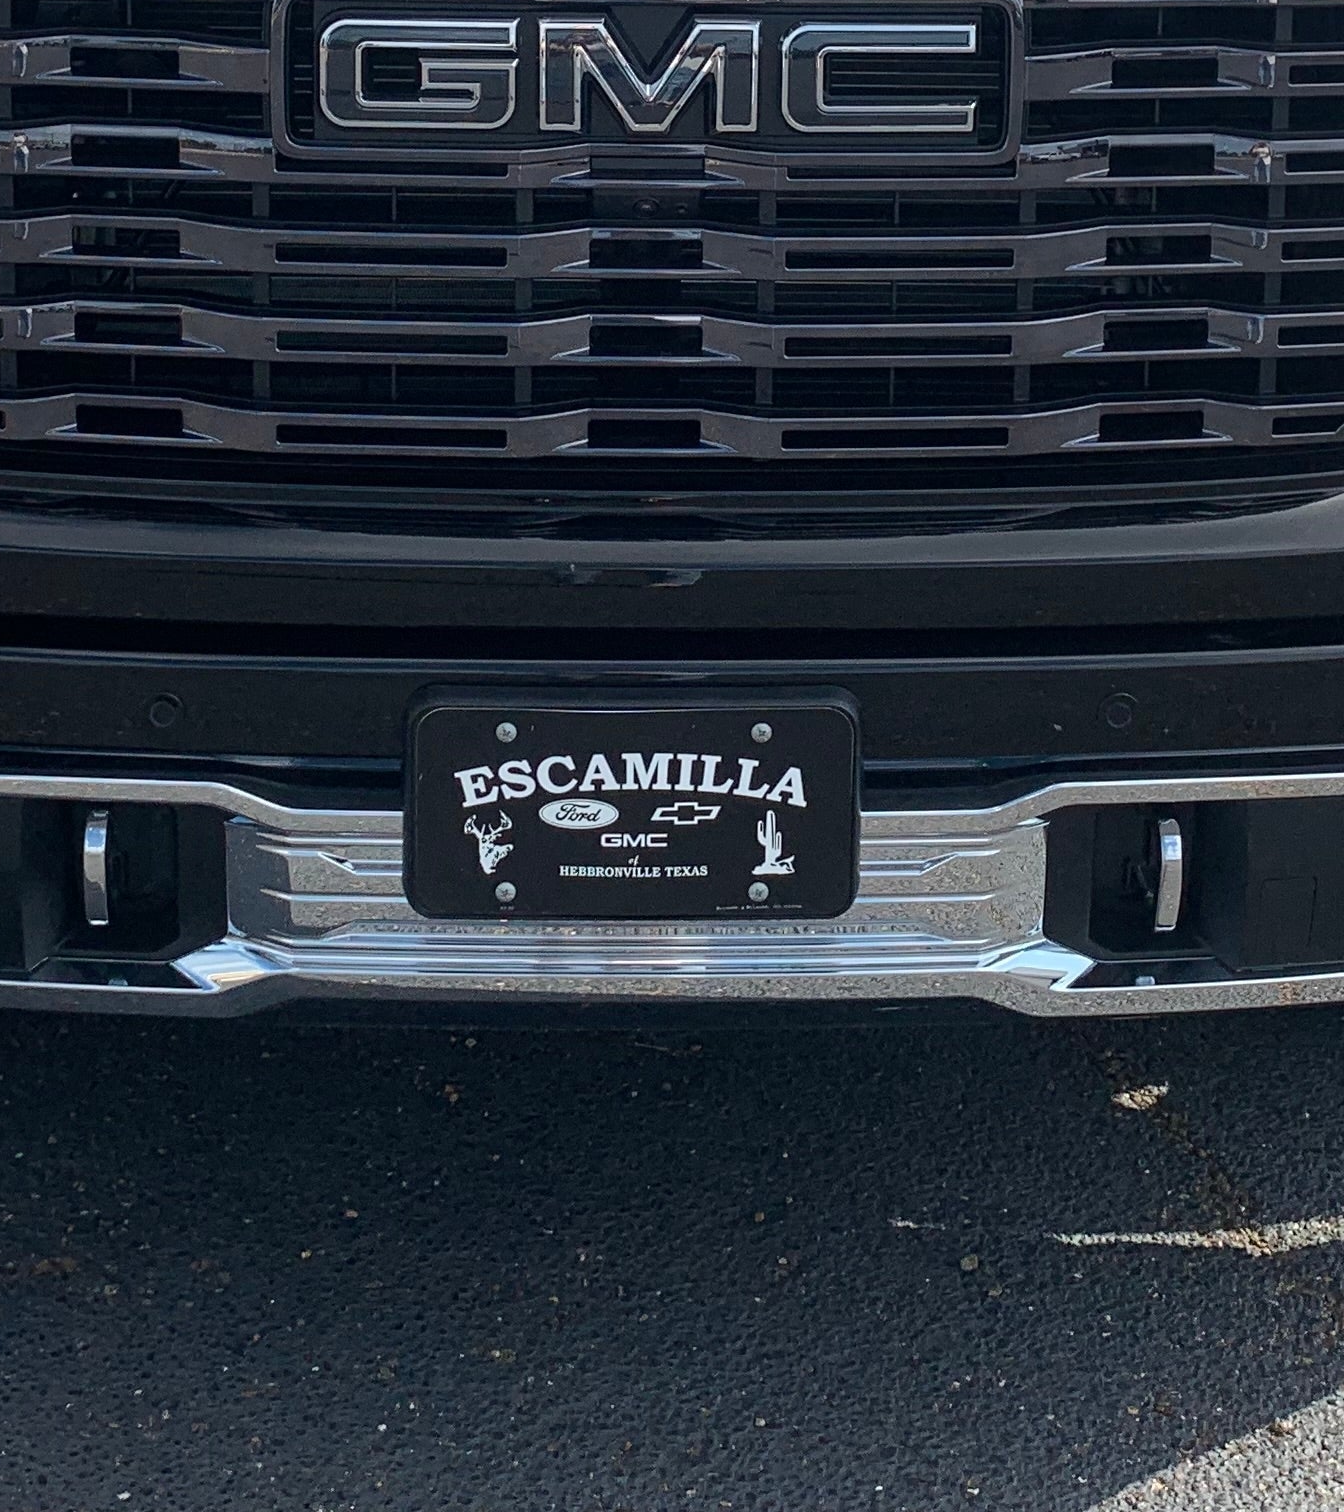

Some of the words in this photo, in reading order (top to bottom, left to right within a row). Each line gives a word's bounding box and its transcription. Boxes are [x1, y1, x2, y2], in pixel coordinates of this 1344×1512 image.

[320, 18, 979, 133] GMC
[454, 752, 808, 808] ESCAMILLA
[555, 803, 601, 823] Ford
[600, 832, 669, 848] GMC
[559, 864, 662, 878] HEBBRONVILLE
[664, 864, 709, 878] TEXAS
